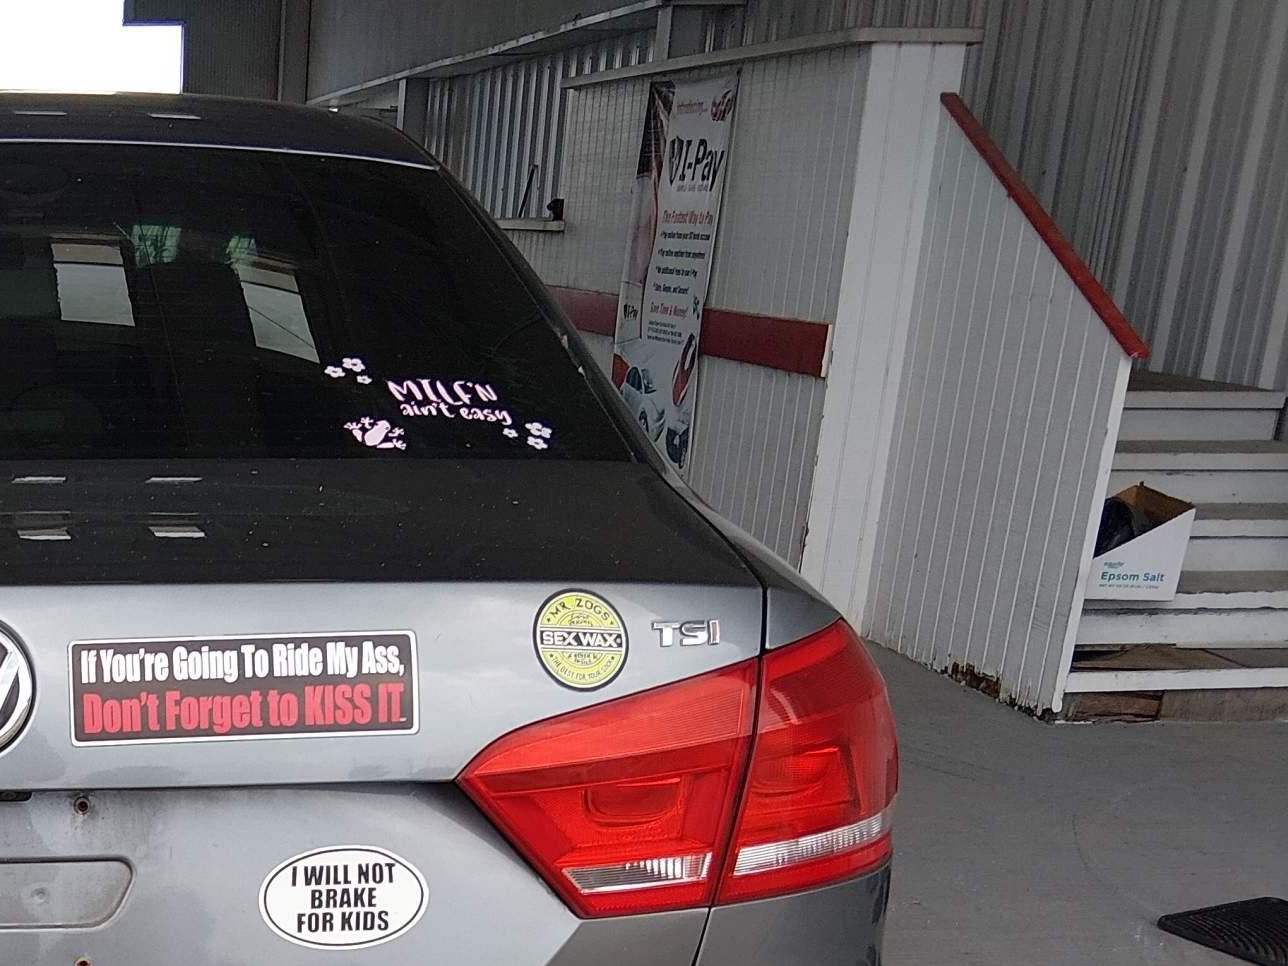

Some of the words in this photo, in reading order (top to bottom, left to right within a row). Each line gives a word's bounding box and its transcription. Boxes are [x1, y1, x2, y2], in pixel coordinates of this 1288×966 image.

[386, 377, 498, 405] MILF'N
[400, 401, 455, 418] ain't
[459, 406, 513, 425] easy
[1100, 571, 1140, 582] Epsom
[1143, 572, 1165, 582] Salt
[549, 601, 571, 618] MR
[575, 598, 610, 621] ZOGS
[542, 630, 578, 646] SEX
[578, 632, 619, 648] WAX
[652, 619, 720, 647] TSI
[81, 649, 97, 684] If
[100, 647, 169, 683] You're
[172, 645, 239, 684] Going
[240, 644, 268, 679] To
[273, 642, 323, 677] Ride
[326, 641, 358, 679] My
[362, 640, 405, 677] Ass,
[83, 692, 161, 735] Don't
[165, 690, 263, 733] Forget
[267, 689, 299, 727] to
[303, 683, 372, 726] KISS
[378, 682, 405, 723] IT
[291, 866, 298, 887] I
[304, 864, 352, 886] WILL
[357, 862, 396, 884] NOT
[311, 887, 377, 909] BRAKE
[297, 912, 334, 933] FOR
[340, 910, 389, 931] KIDS
